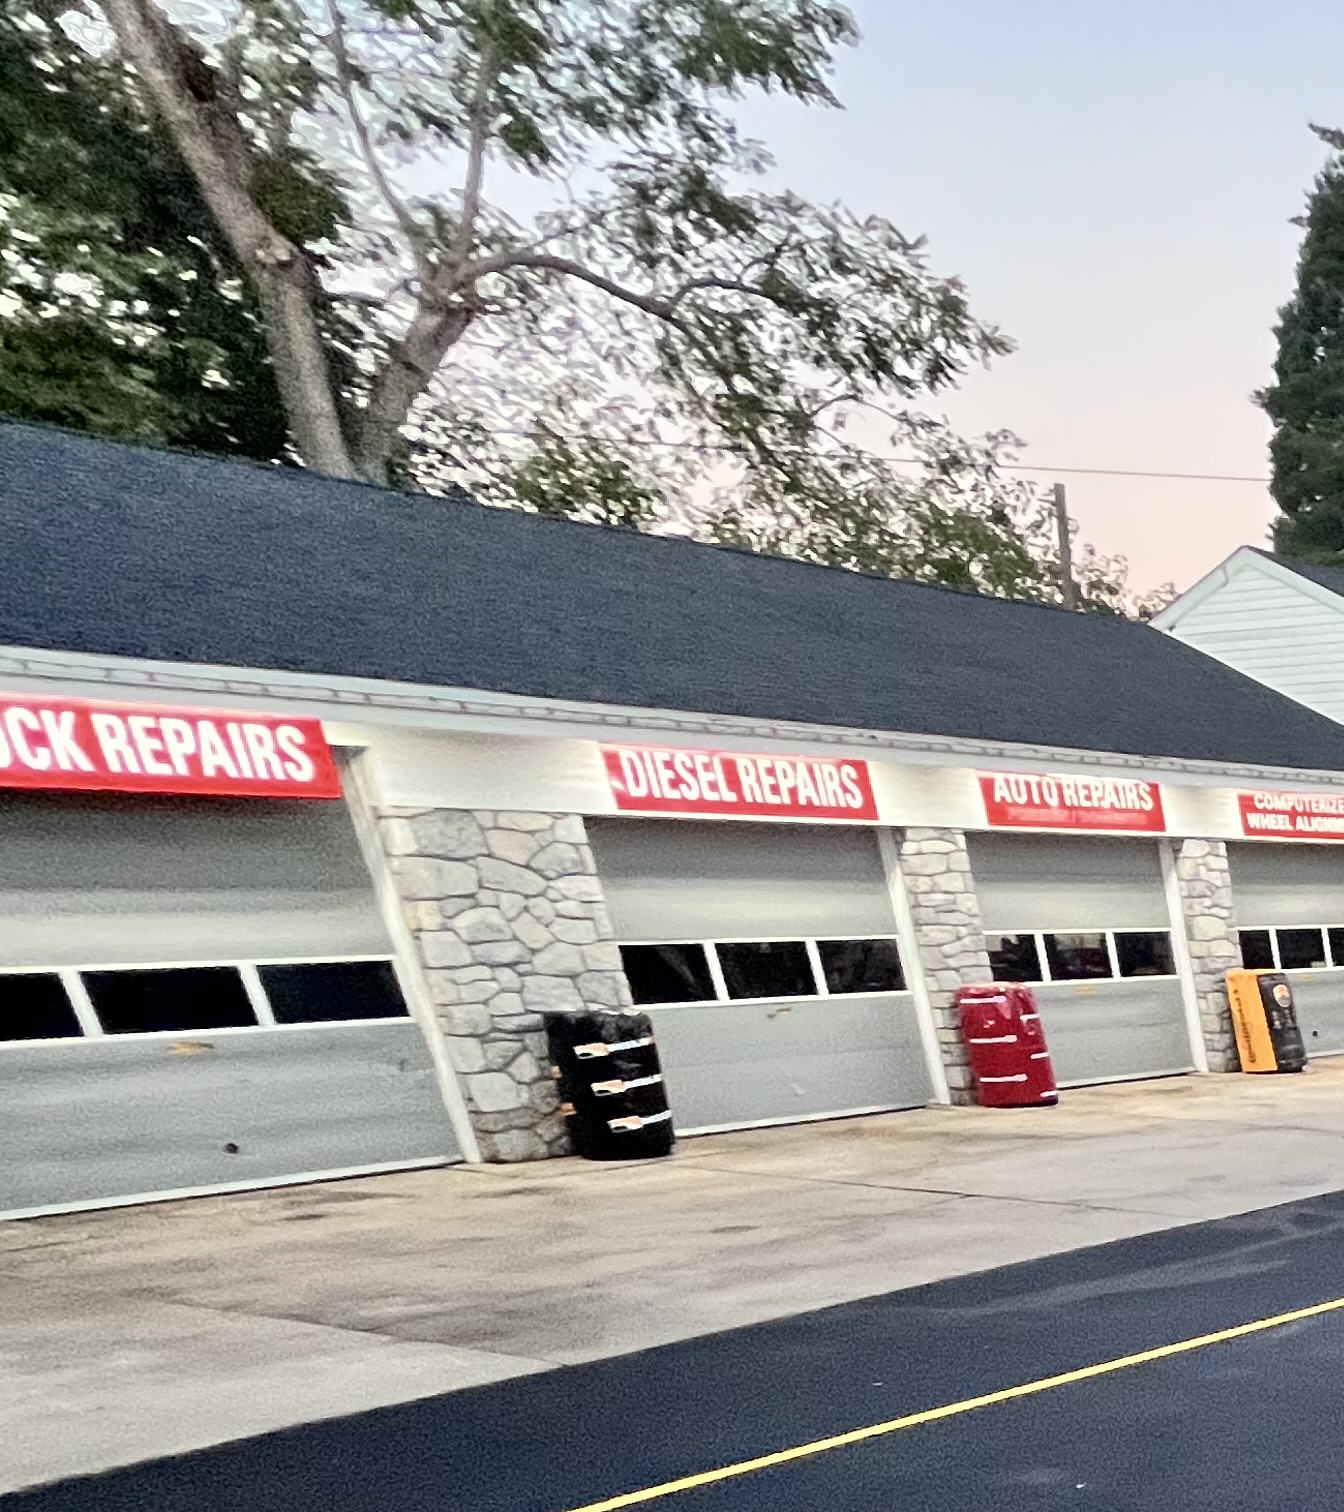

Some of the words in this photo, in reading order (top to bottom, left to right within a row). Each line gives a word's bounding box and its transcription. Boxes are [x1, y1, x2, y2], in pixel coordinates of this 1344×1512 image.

[0, 706, 96, 772] CK
[90, 712, 315, 782] REPAIRS
[618, 749, 739, 802] DIESEL
[736, 757, 864, 810] REPAIRS
[994, 774, 1059, 807] AUTO
[1061, 779, 1154, 811] REPAIRS
[1246, 812, 1294, 831] WHEEL
